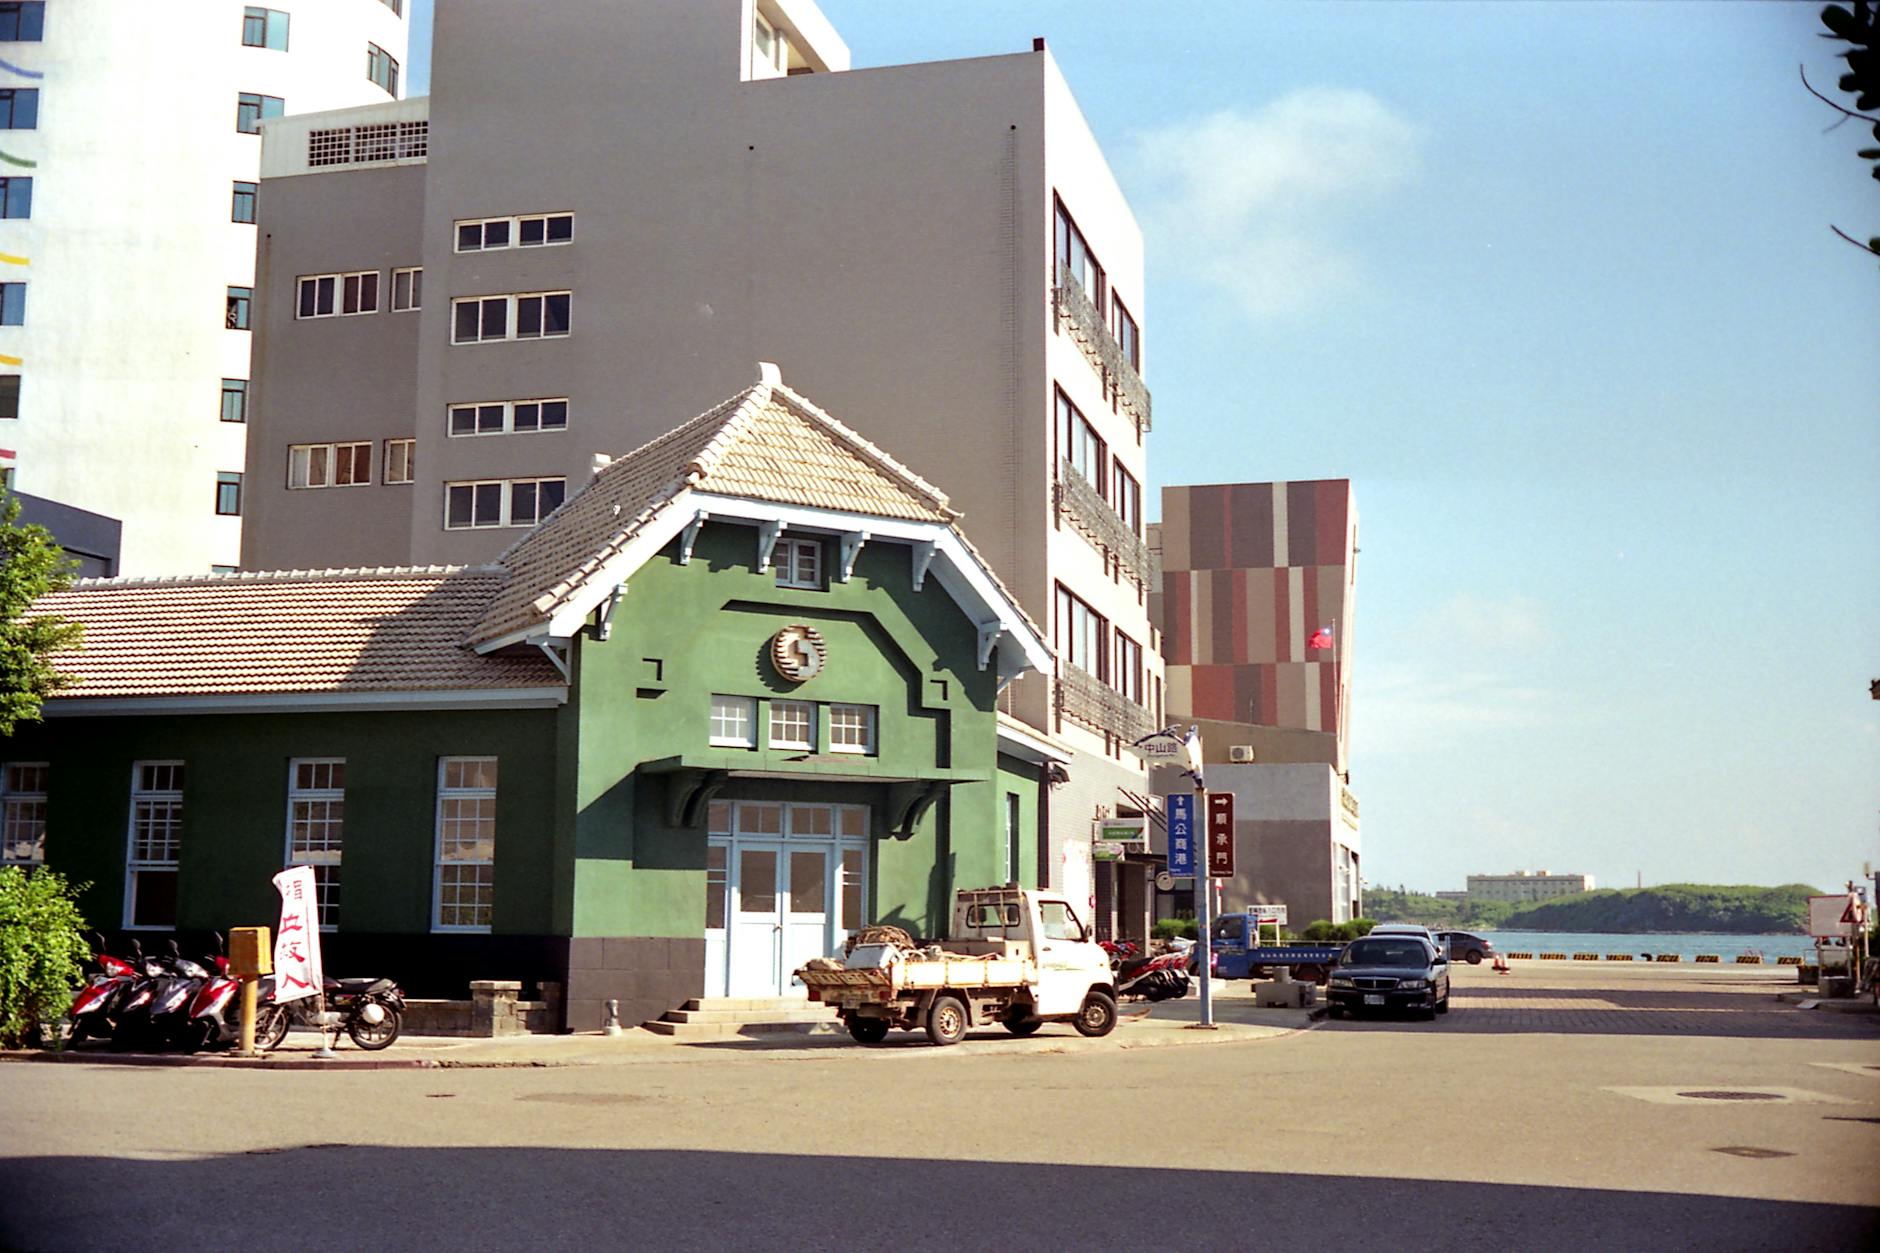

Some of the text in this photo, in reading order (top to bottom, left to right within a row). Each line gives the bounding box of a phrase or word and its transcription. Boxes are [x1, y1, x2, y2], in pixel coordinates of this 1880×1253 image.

[1145, 743, 1177, 754] 中山路
[1174, 808, 1187, 865] 馬公商港
[1216, 813, 1228, 865] 順承門
